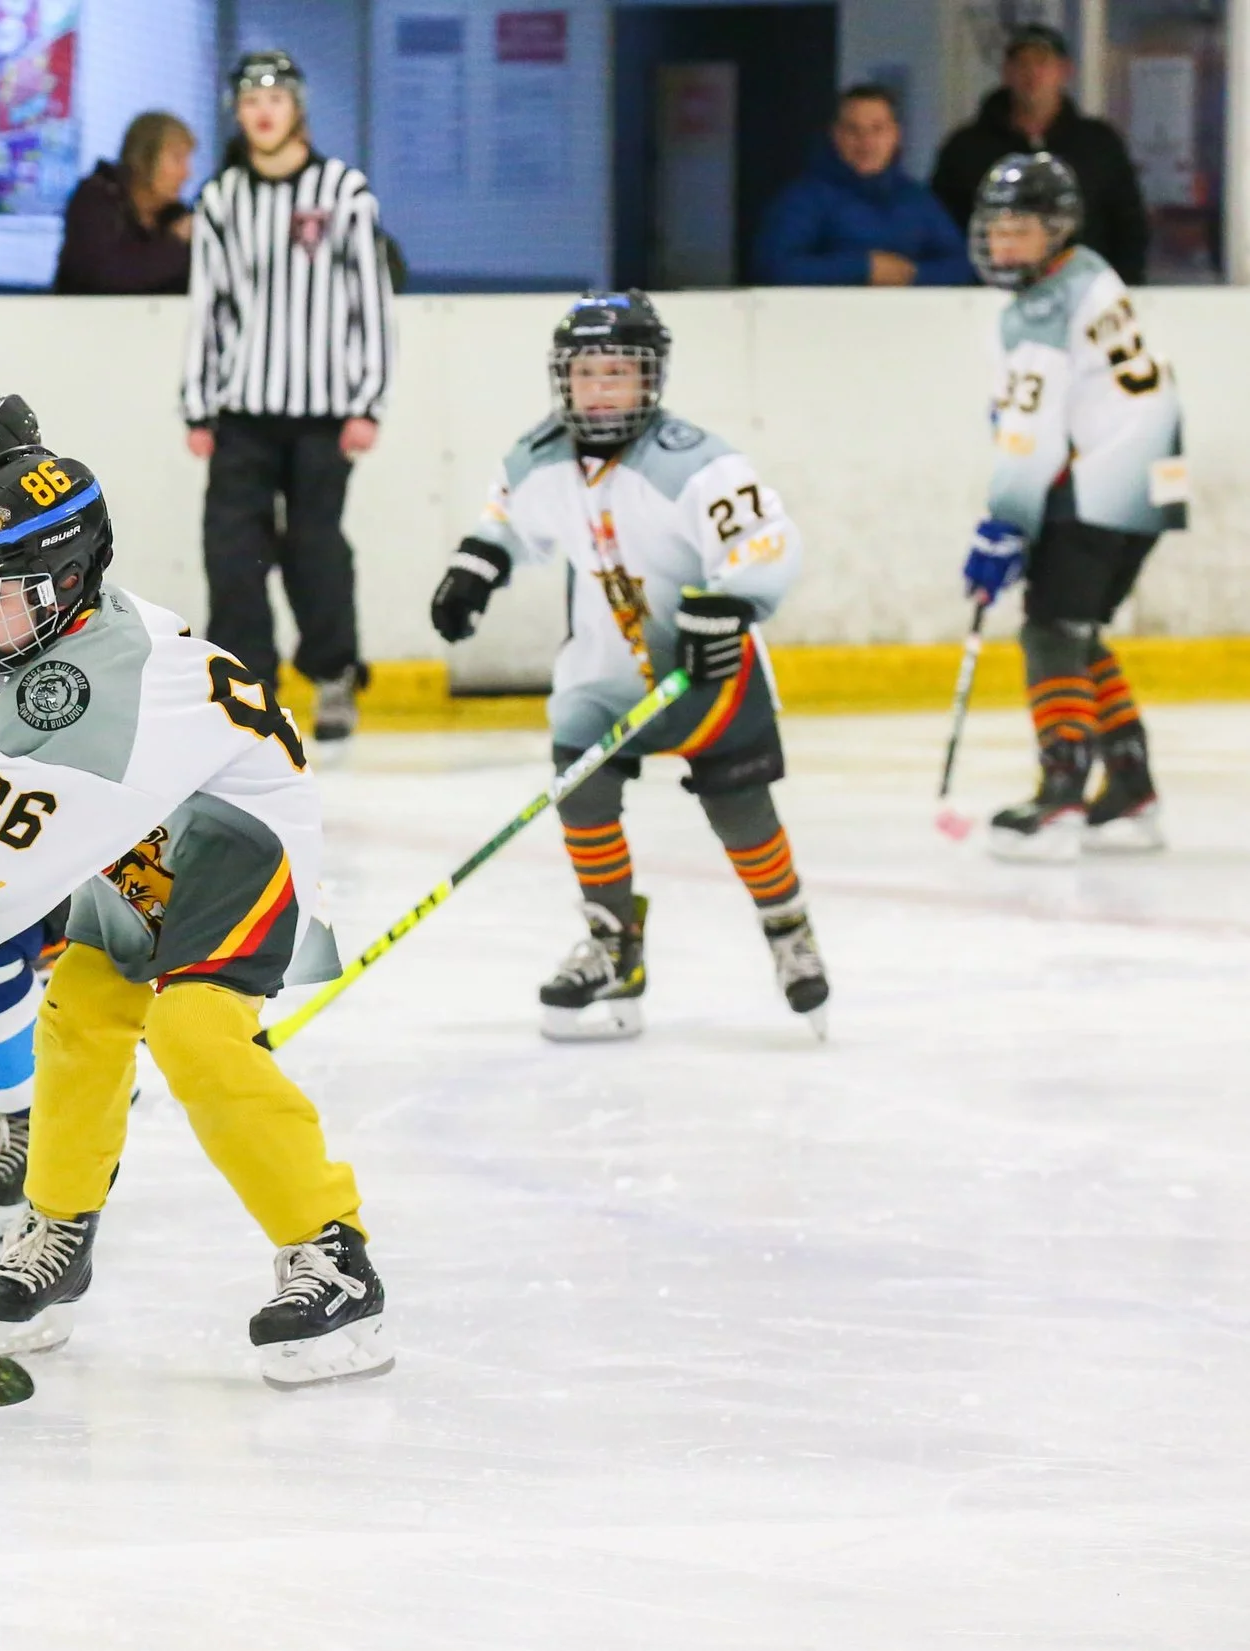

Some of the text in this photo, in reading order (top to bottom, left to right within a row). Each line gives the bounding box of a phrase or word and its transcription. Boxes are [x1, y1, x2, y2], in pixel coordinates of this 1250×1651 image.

[20, 460, 72, 507] 86
[708, 483, 764, 543] 27
[40, 525, 82, 548] BAUER
[44, 662, 51, 670] A
[54, 662, 88, 690] BULLDOG
[42, 720, 48, 730] A
[50, 703, 85, 729] BULLDOG
